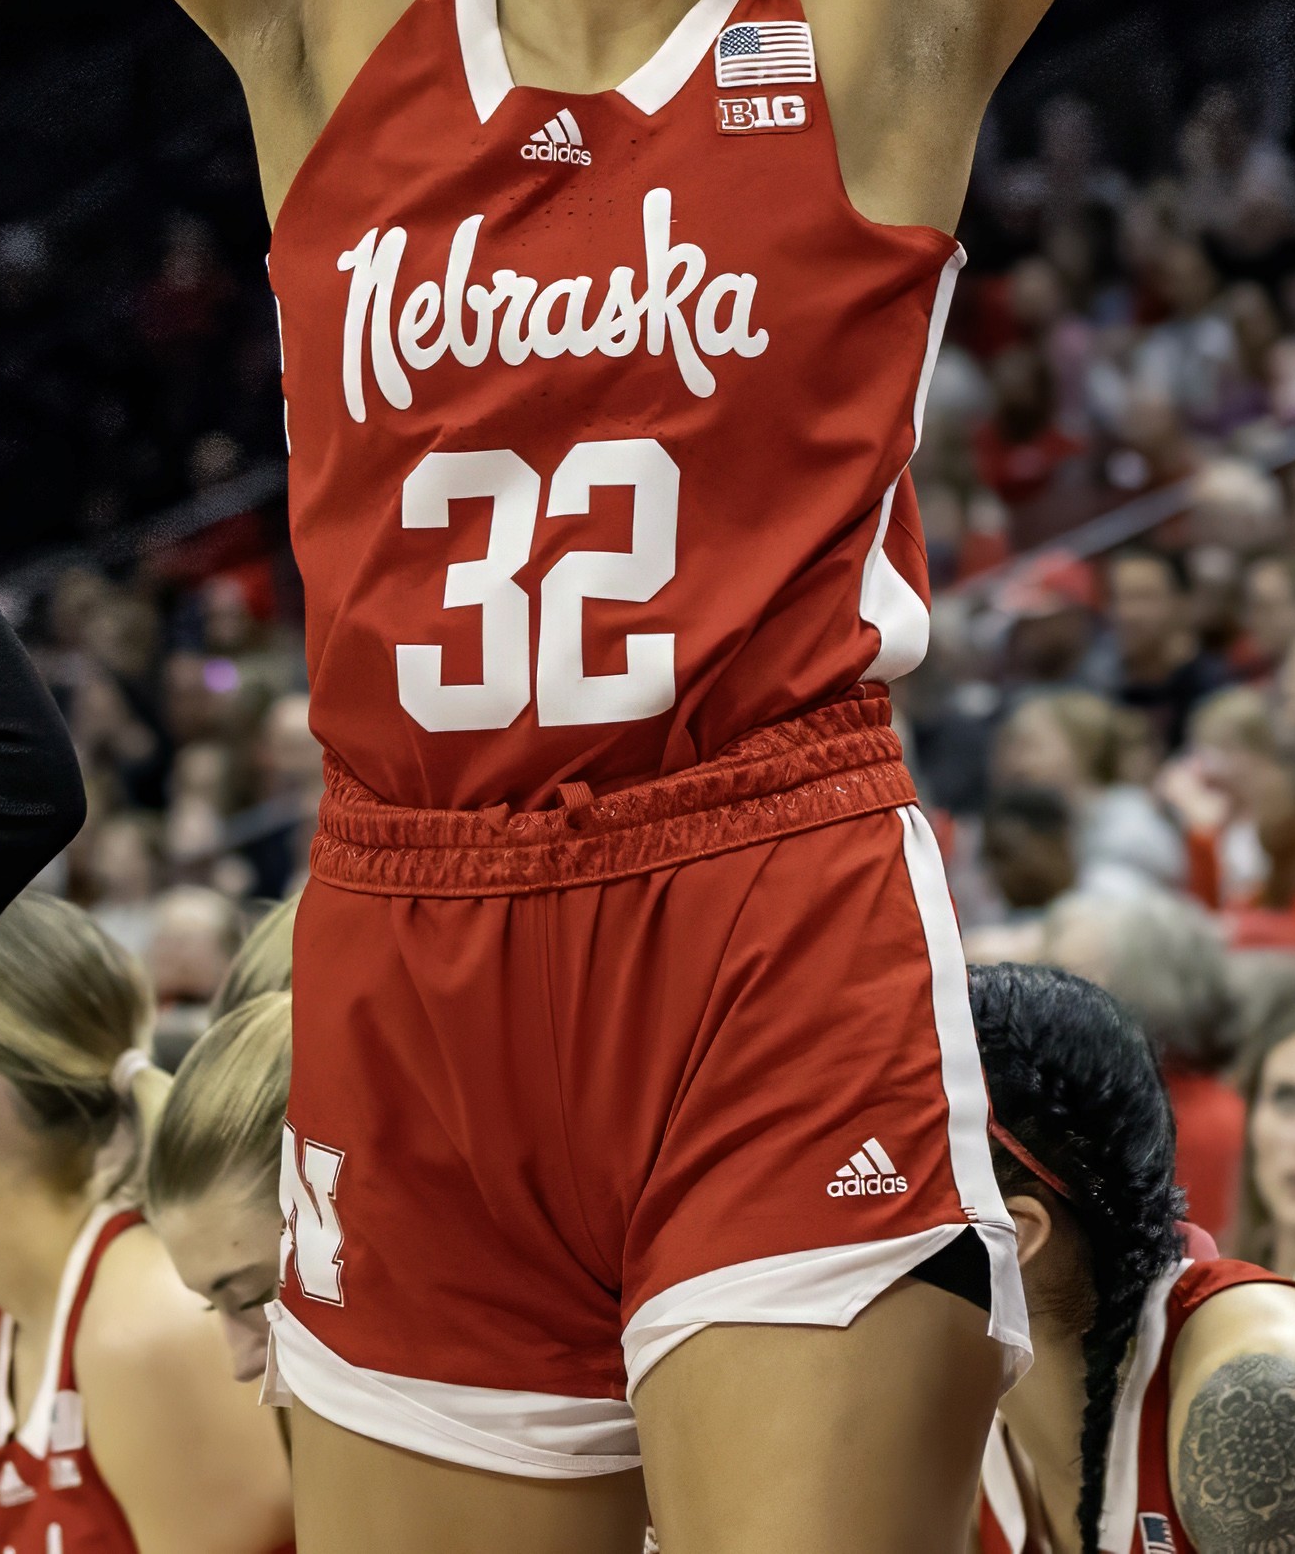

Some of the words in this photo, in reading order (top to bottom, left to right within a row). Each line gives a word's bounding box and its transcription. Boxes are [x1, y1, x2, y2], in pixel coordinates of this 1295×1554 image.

[520, 141, 592, 166] adidas
[337, 187, 770, 424] Nebraska
[396, 438, 681, 733] 32
[826, 1174, 909, 1197] adidas
